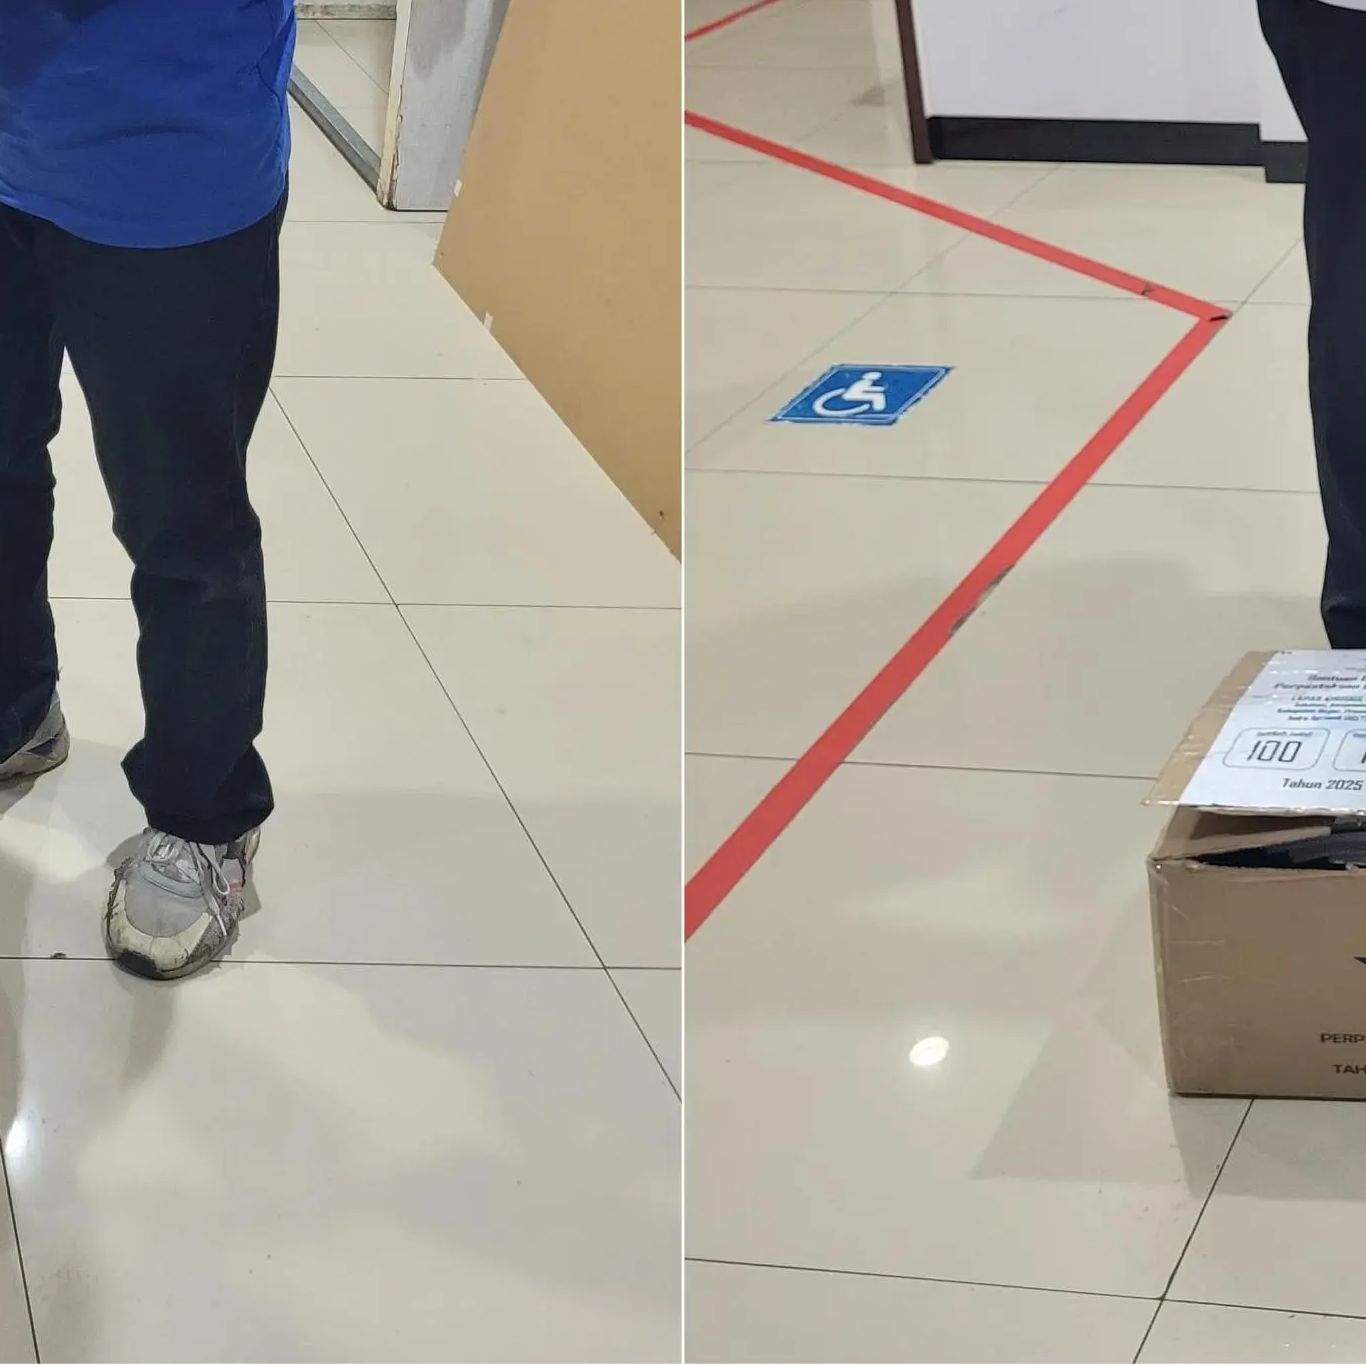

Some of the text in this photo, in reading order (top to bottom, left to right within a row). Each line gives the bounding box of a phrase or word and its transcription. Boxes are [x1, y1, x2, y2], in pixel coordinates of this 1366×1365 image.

[1247, 740, 1302, 763] 100
[1283, 778, 1363, 790] Tahun 2025
